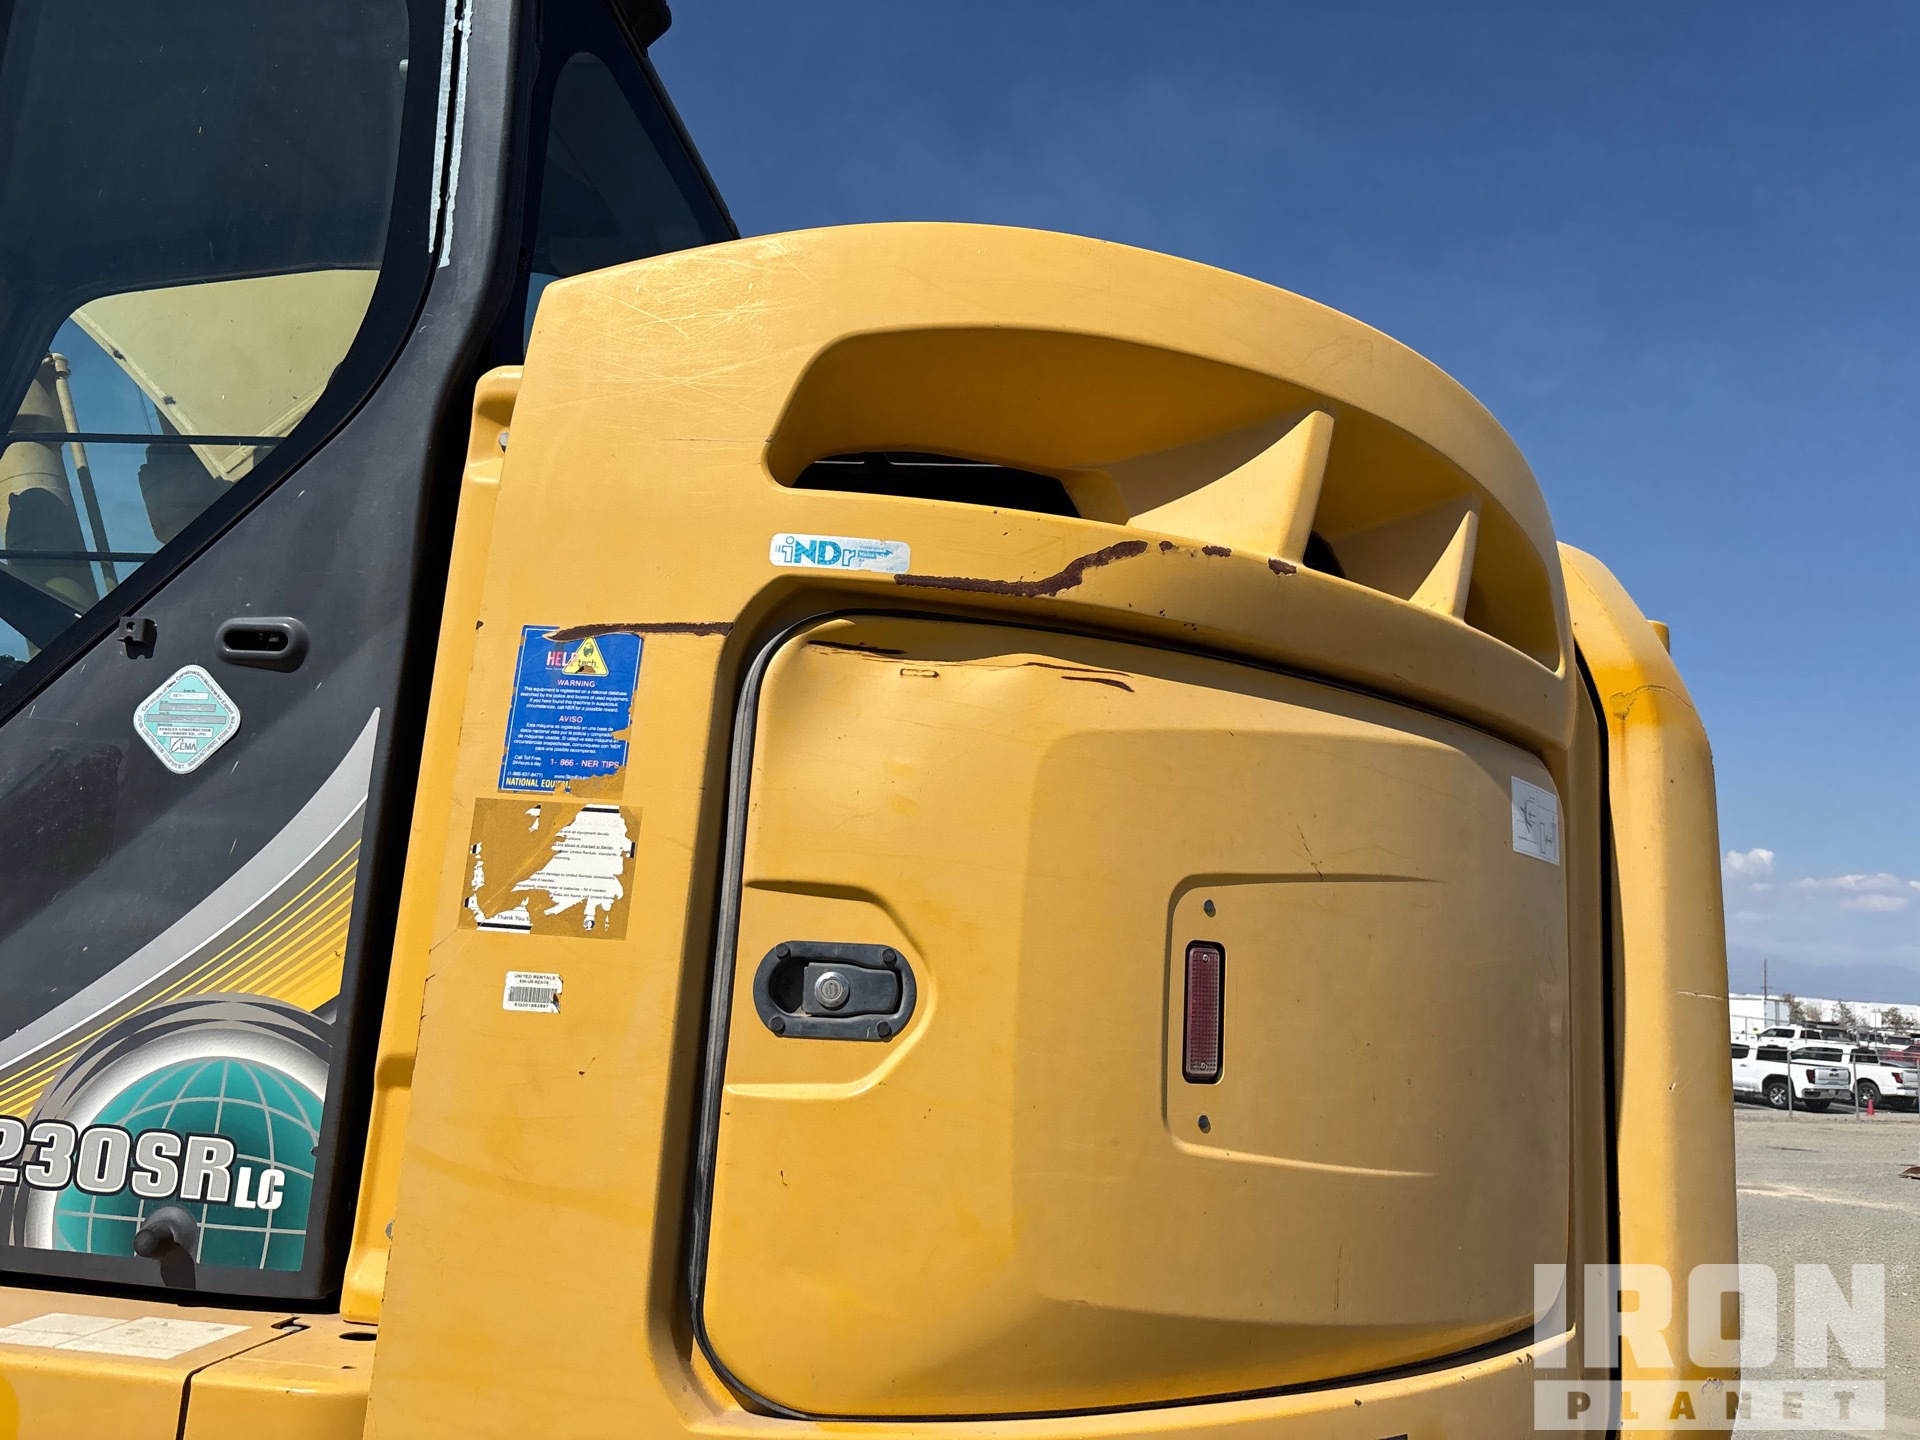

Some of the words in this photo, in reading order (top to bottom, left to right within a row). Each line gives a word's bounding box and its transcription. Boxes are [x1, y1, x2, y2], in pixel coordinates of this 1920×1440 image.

[557, 679, 596, 688] WARNING
[506, 777, 540, 788] NATIONAL
[235, 1167, 285, 1210] LC
